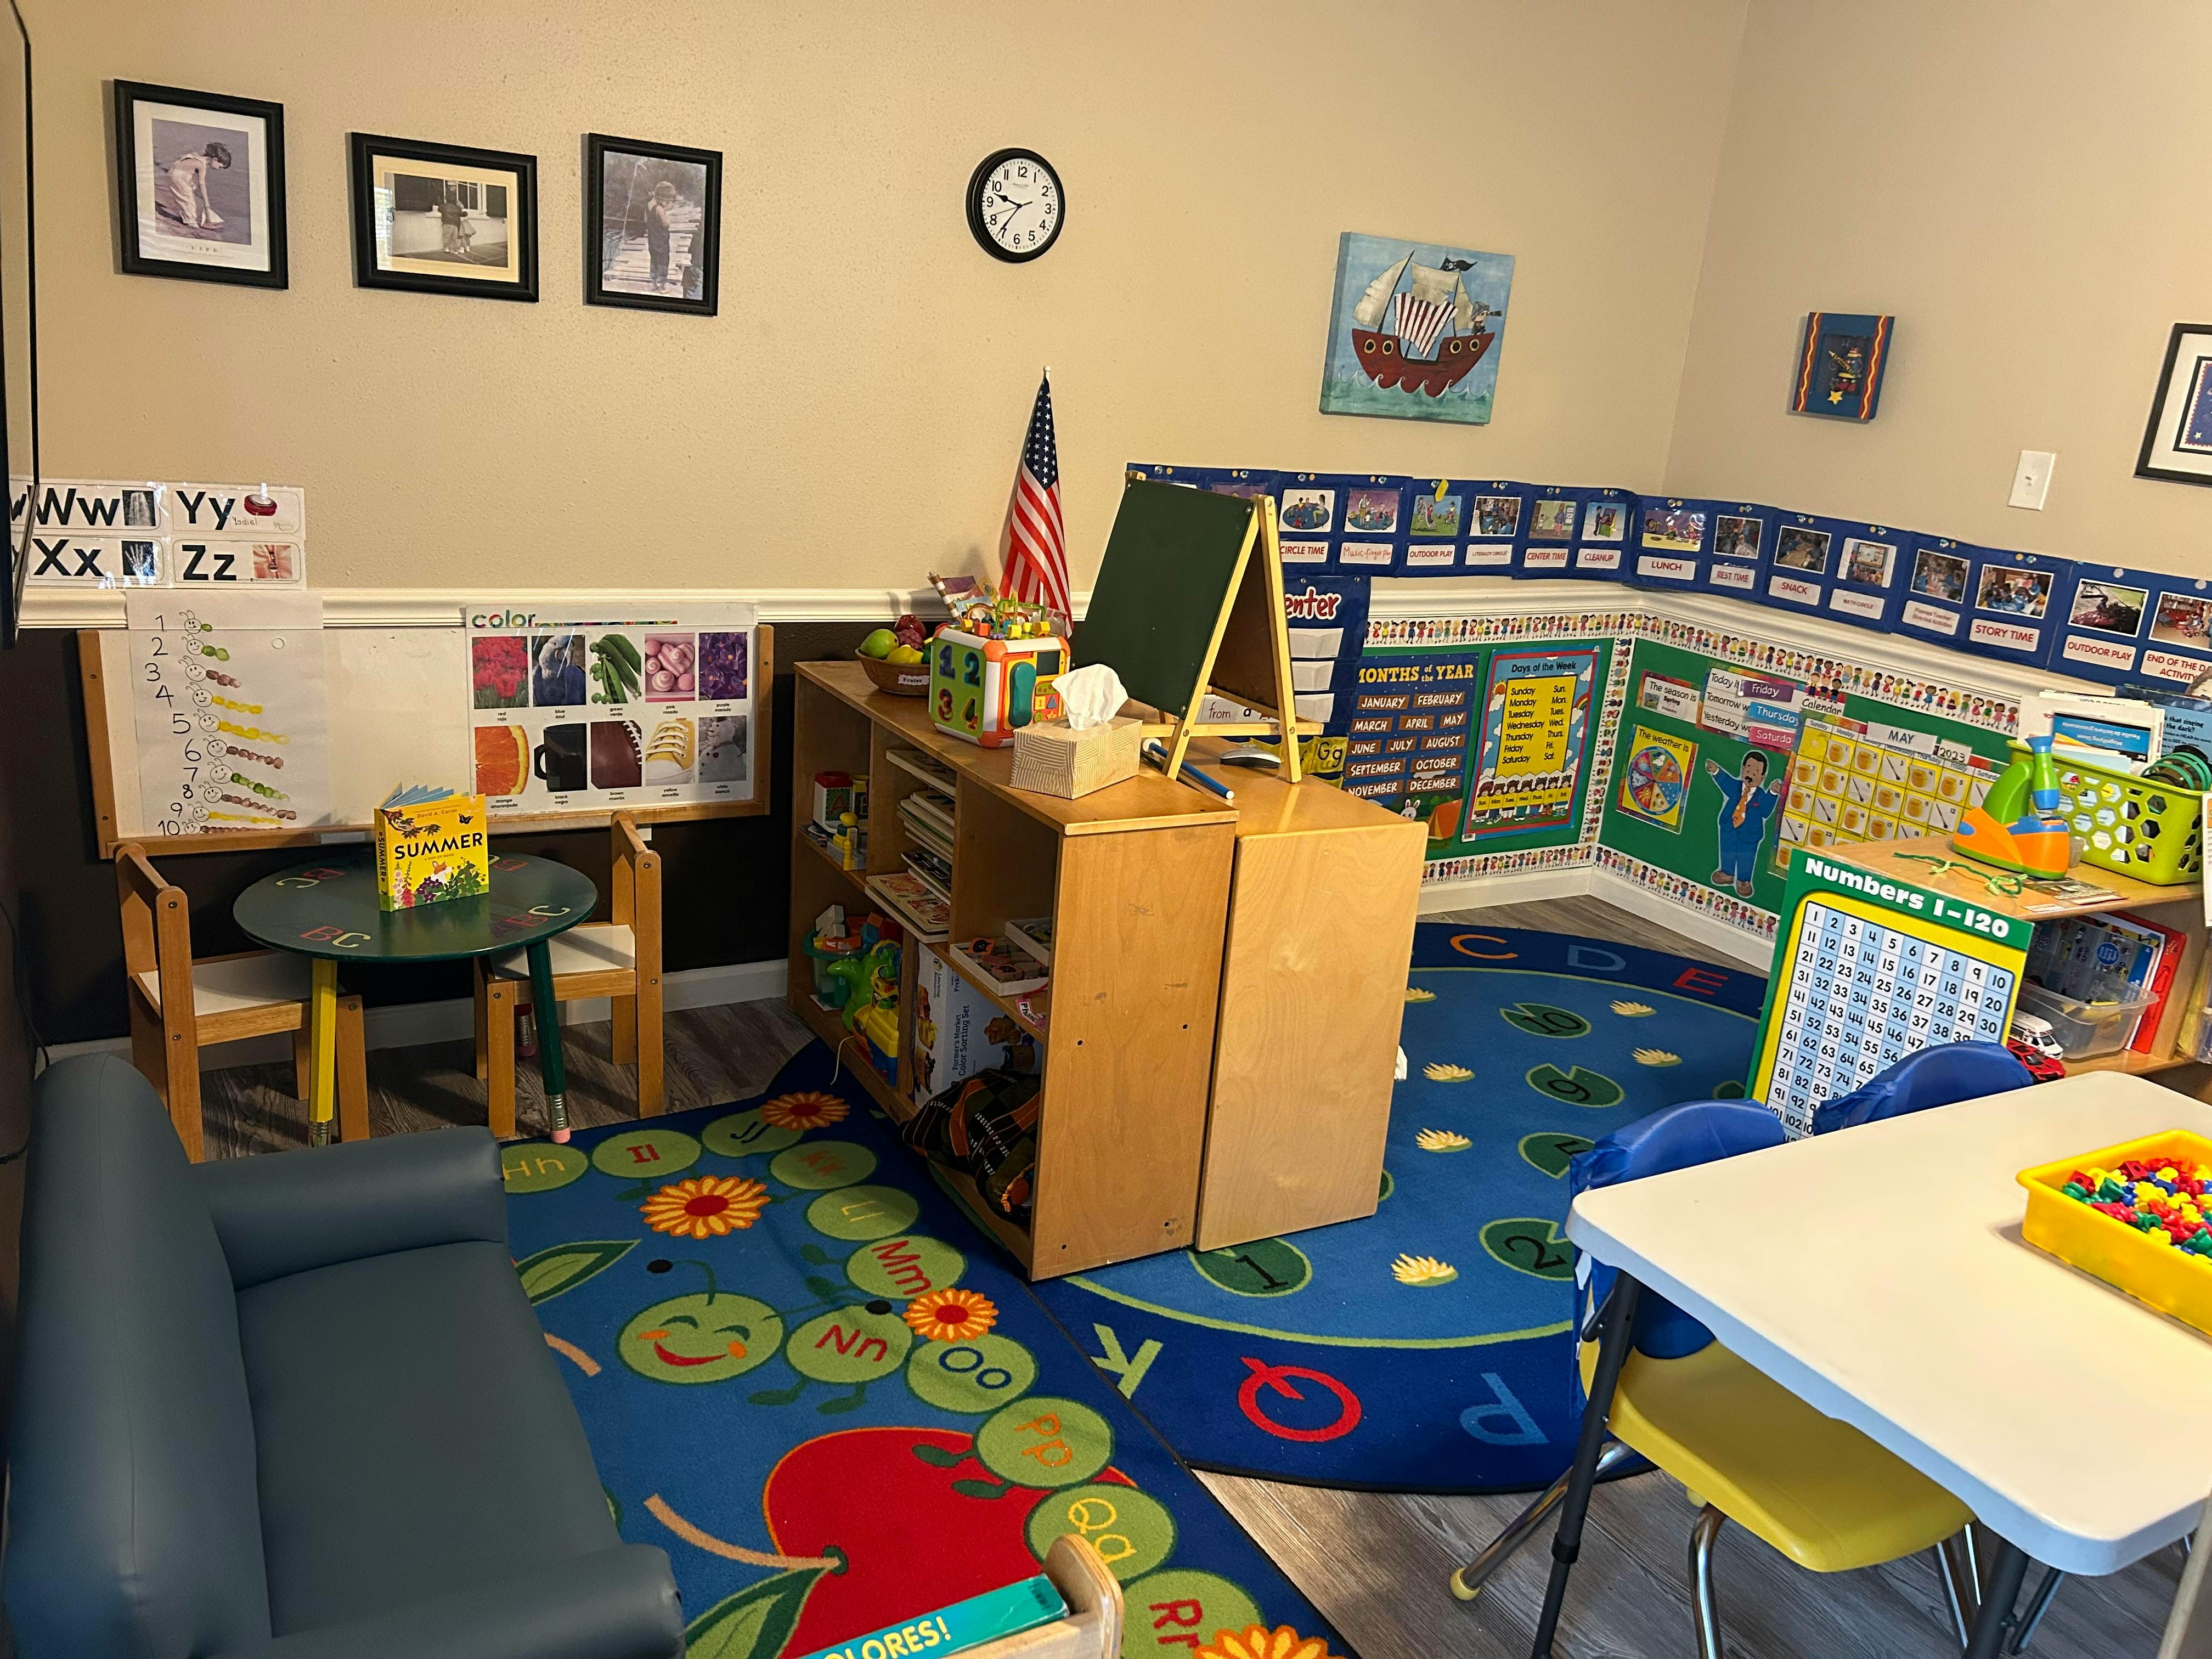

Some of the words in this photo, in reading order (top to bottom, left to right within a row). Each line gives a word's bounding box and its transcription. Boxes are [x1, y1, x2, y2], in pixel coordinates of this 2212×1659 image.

[1004, 169, 1009, 180] 11
[1018, 166, 1028, 178] 12
[1034, 172, 1036, 183] 1
[992, 180, 1002, 192] 10
[1042, 185, 1048, 196] 2
[986, 196, 994, 207] 9
[1045, 204, 1052, 214] 3
[990, 215, 997, 225] 8
[1040, 219, 1046, 230] 4
[1013, 234, 1020, 245] 6
[1029, 230, 1035, 241] 5
[176, 491, 235, 531] Yy
[32, 538, 105, 576] Xx
[1280, 546, 1305, 555] CIRCLE
[1308, 546, 1325, 555] TIME
[1440, 550, 1453, 558] PLAY
[1527, 552, 1550, 561] CENTER
[1552, 552, 1566, 561] TIME
[1584, 554, 1614, 562] CLEANUP
[182, 545, 237, 581] Zz
[1651, 561, 1682, 571] LUNCH
[1716, 571, 1732, 580] REST
[1734, 574, 1748, 583] TIME
[1781, 582, 1808, 595] SNACK
[1284, 587, 1341, 619] enter
[155, 616, 164, 631] 1
[472, 610, 535, 628] color
[1975, 625, 2008, 639] STORY
[2010, 630, 2034, 643] TIME
[152, 637, 168, 656] 2
[2068, 641, 2109, 656] OUTDOOR
[2112, 651, 2132, 661] PLAY
[1511, 664, 1531, 673] Days
[1556, 662, 1577, 670] Week
[2147, 654, 2165, 665] END
[2168, 658, 2179, 667] OF
[2180, 659, 2198, 670] THE
[145, 663, 160, 681] 3
[1436, 664, 1474, 680] YEAR
[2159, 668, 2196, 682] ACTIVITY
[1711, 673, 1733, 688] Today
[155, 686, 174, 708] 4
[1511, 687, 1536, 696] Sunday
[1650, 681, 1662, 692] The
[1664, 686, 1689, 700] season
[1691, 693, 1696, 702] is
[1752, 684, 1779, 697] Friday
[1362, 697, 1406, 708] JANUARY
[1418, 693, 1462, 706] FEBRUARY
[1509, 699, 1536, 707] Monday
[1663, 696, 1680, 705] Spring
[1707, 692, 1741, 708] Tomorrow
[1802, 699, 1842, 715] Calendar
[1209, 702, 1231, 719] from
[1243, 708, 1251, 718] a
[1508, 710, 1534, 719] Tuesday
[1757, 707, 1799, 726] Thursday
[173, 714, 190, 733] 5
[1355, 720, 1387, 731] MARCH
[1406, 718, 1428, 729] APRIL
[1443, 714, 1463, 725] MAY
[1507, 721, 1544, 730] Wednesday
[1704, 711, 1740, 731] Yesterday
[1810, 720, 1827, 730] Sunday
[1506, 733, 1533, 741] Thursday
[1639, 729, 1651, 740] The
[1652, 735, 1681, 749] weather
[1683, 743, 1689, 752] is
[1756, 730, 1792, 744] Saturda
[1837, 728, 1854, 739] Monday
[1888, 730, 1915, 744] MAY
[185, 740, 201, 761] 6
[1352, 743, 1375, 754] JUNE
[1390, 740, 1413, 751] JULY
[1426, 736, 1460, 748] AUGUST
[1504, 744, 1523, 753] Friday
[1318, 741, 1342, 768] Gg
[1502, 755, 1531, 764] Saturday
[1940, 748, 1965, 763] 2023
[183, 768, 198, 782] 7
[1351, 762, 1400, 776] SEPTEMBER
[1416, 758, 1457, 770] OCTOBER
[183, 785, 193, 798] 8
[1348, 782, 1397, 797] NOVEMBER
[1410, 778, 1455, 791] DECEMBER
[171, 803, 182, 816] 9
[158, 821, 180, 836] 10
[394, 832, 483, 860] SUMMER
[378, 837, 386, 877] SUMMER
[1805, 857, 1924, 910] Numbers
[1933, 899, 2009, 938] 1-120
[1450, 933, 1518, 960] C
[1814, 911, 1818, 921] 1
[1831, 918, 1838, 928] 2
[1849, 924, 1857, 935] 3
[1869, 931, 1876, 942] 4
[1889, 938, 1897, 949] 5
[1909, 946, 1916, 956] 6
[1931, 952, 1938, 963] 7
[1951, 960, 1959, 972] 8
[1973, 968, 1981, 980] 9
[1992, 974, 2005, 989] 10
[1567, 945, 1626, 972] D
[1672, 967, 1728, 995] E
[960, 1020, 970, 1052] Sorting
[1505, 1235, 1566, 1271] 2
[872, 1240, 931, 1296] Mm
[815, 1325, 889, 1362] Nn
[938, 1346, 1012, 1390] Oo
[1237, 1357, 1362, 1443] Q
[1014, 1413, 1073, 1467] Pp
[1150, 1599, 1203, 1647] Rr
[824, 1616, 951, 1659] ORES!
